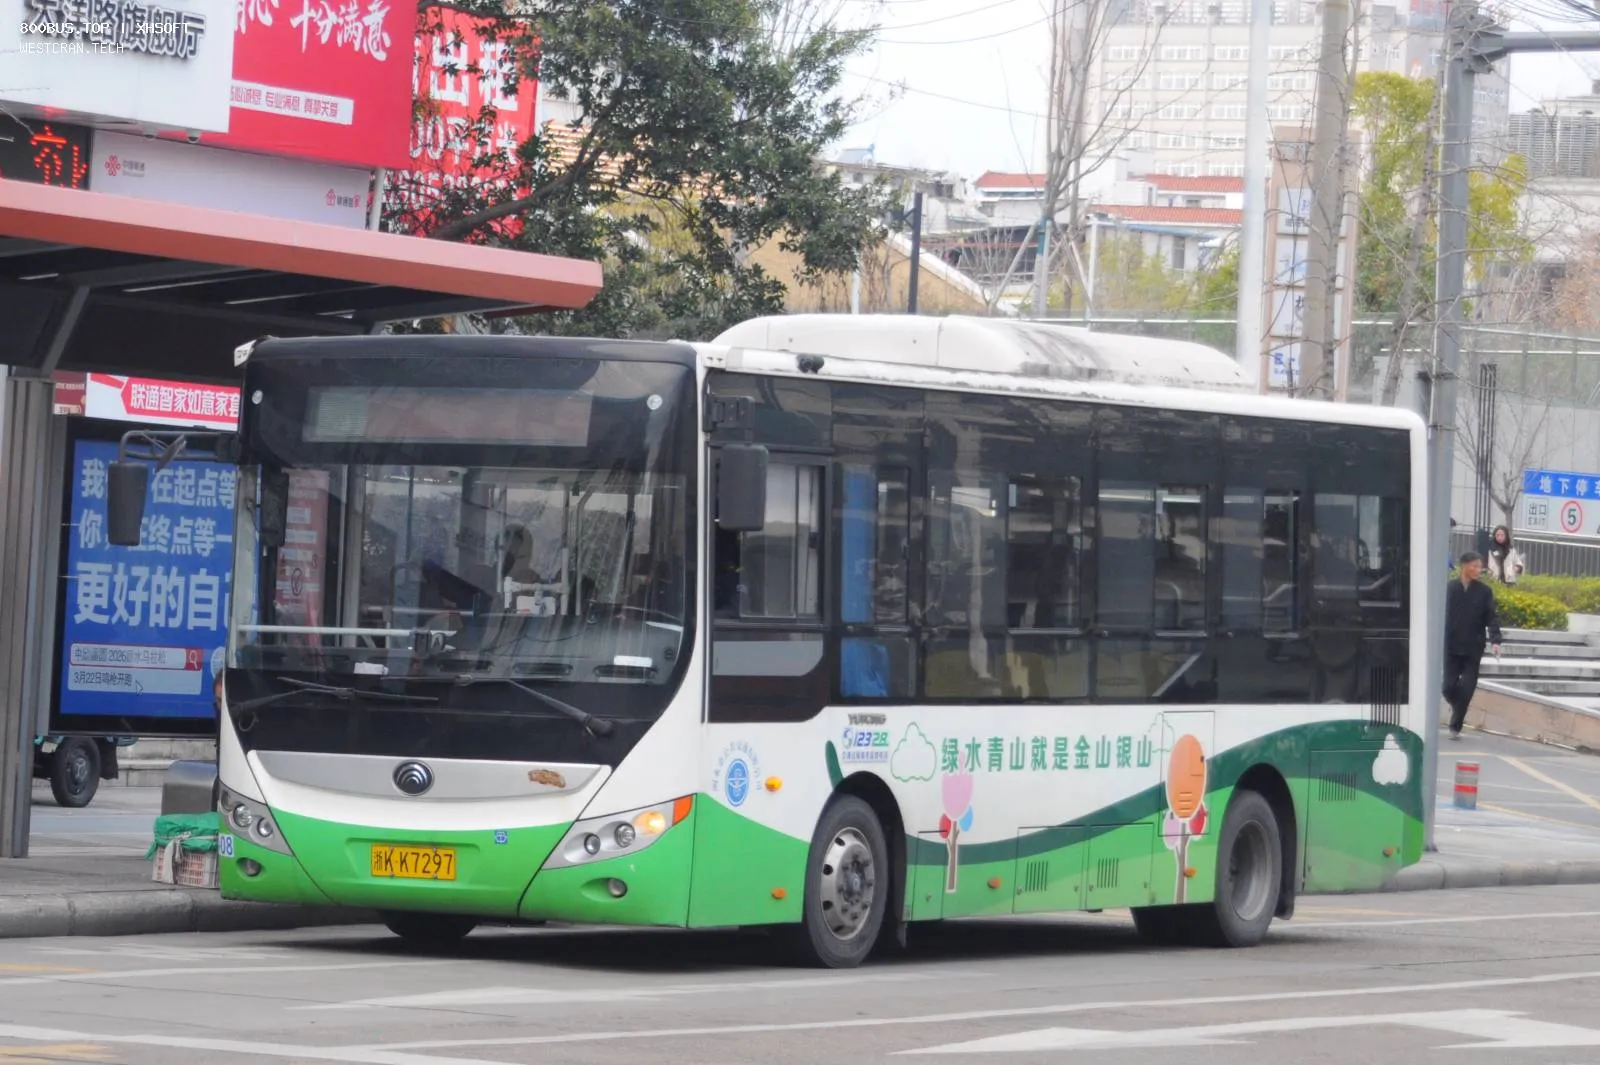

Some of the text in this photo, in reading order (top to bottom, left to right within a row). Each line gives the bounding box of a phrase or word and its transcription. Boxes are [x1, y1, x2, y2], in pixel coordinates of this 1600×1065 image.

[289, 0, 391, 61] 十分满意
[81, 459, 236, 509] 我在起点等
[1527, 503, 1547, 515] 出口
[1567, 508, 1577, 526] 5
[78, 509, 233, 557] 你终点等一
[74, 562, 232, 631] 更好的自
[853, 731, 889, 747] 12328
[941, 735, 1152, 772] 绿水青山就是金山银山
